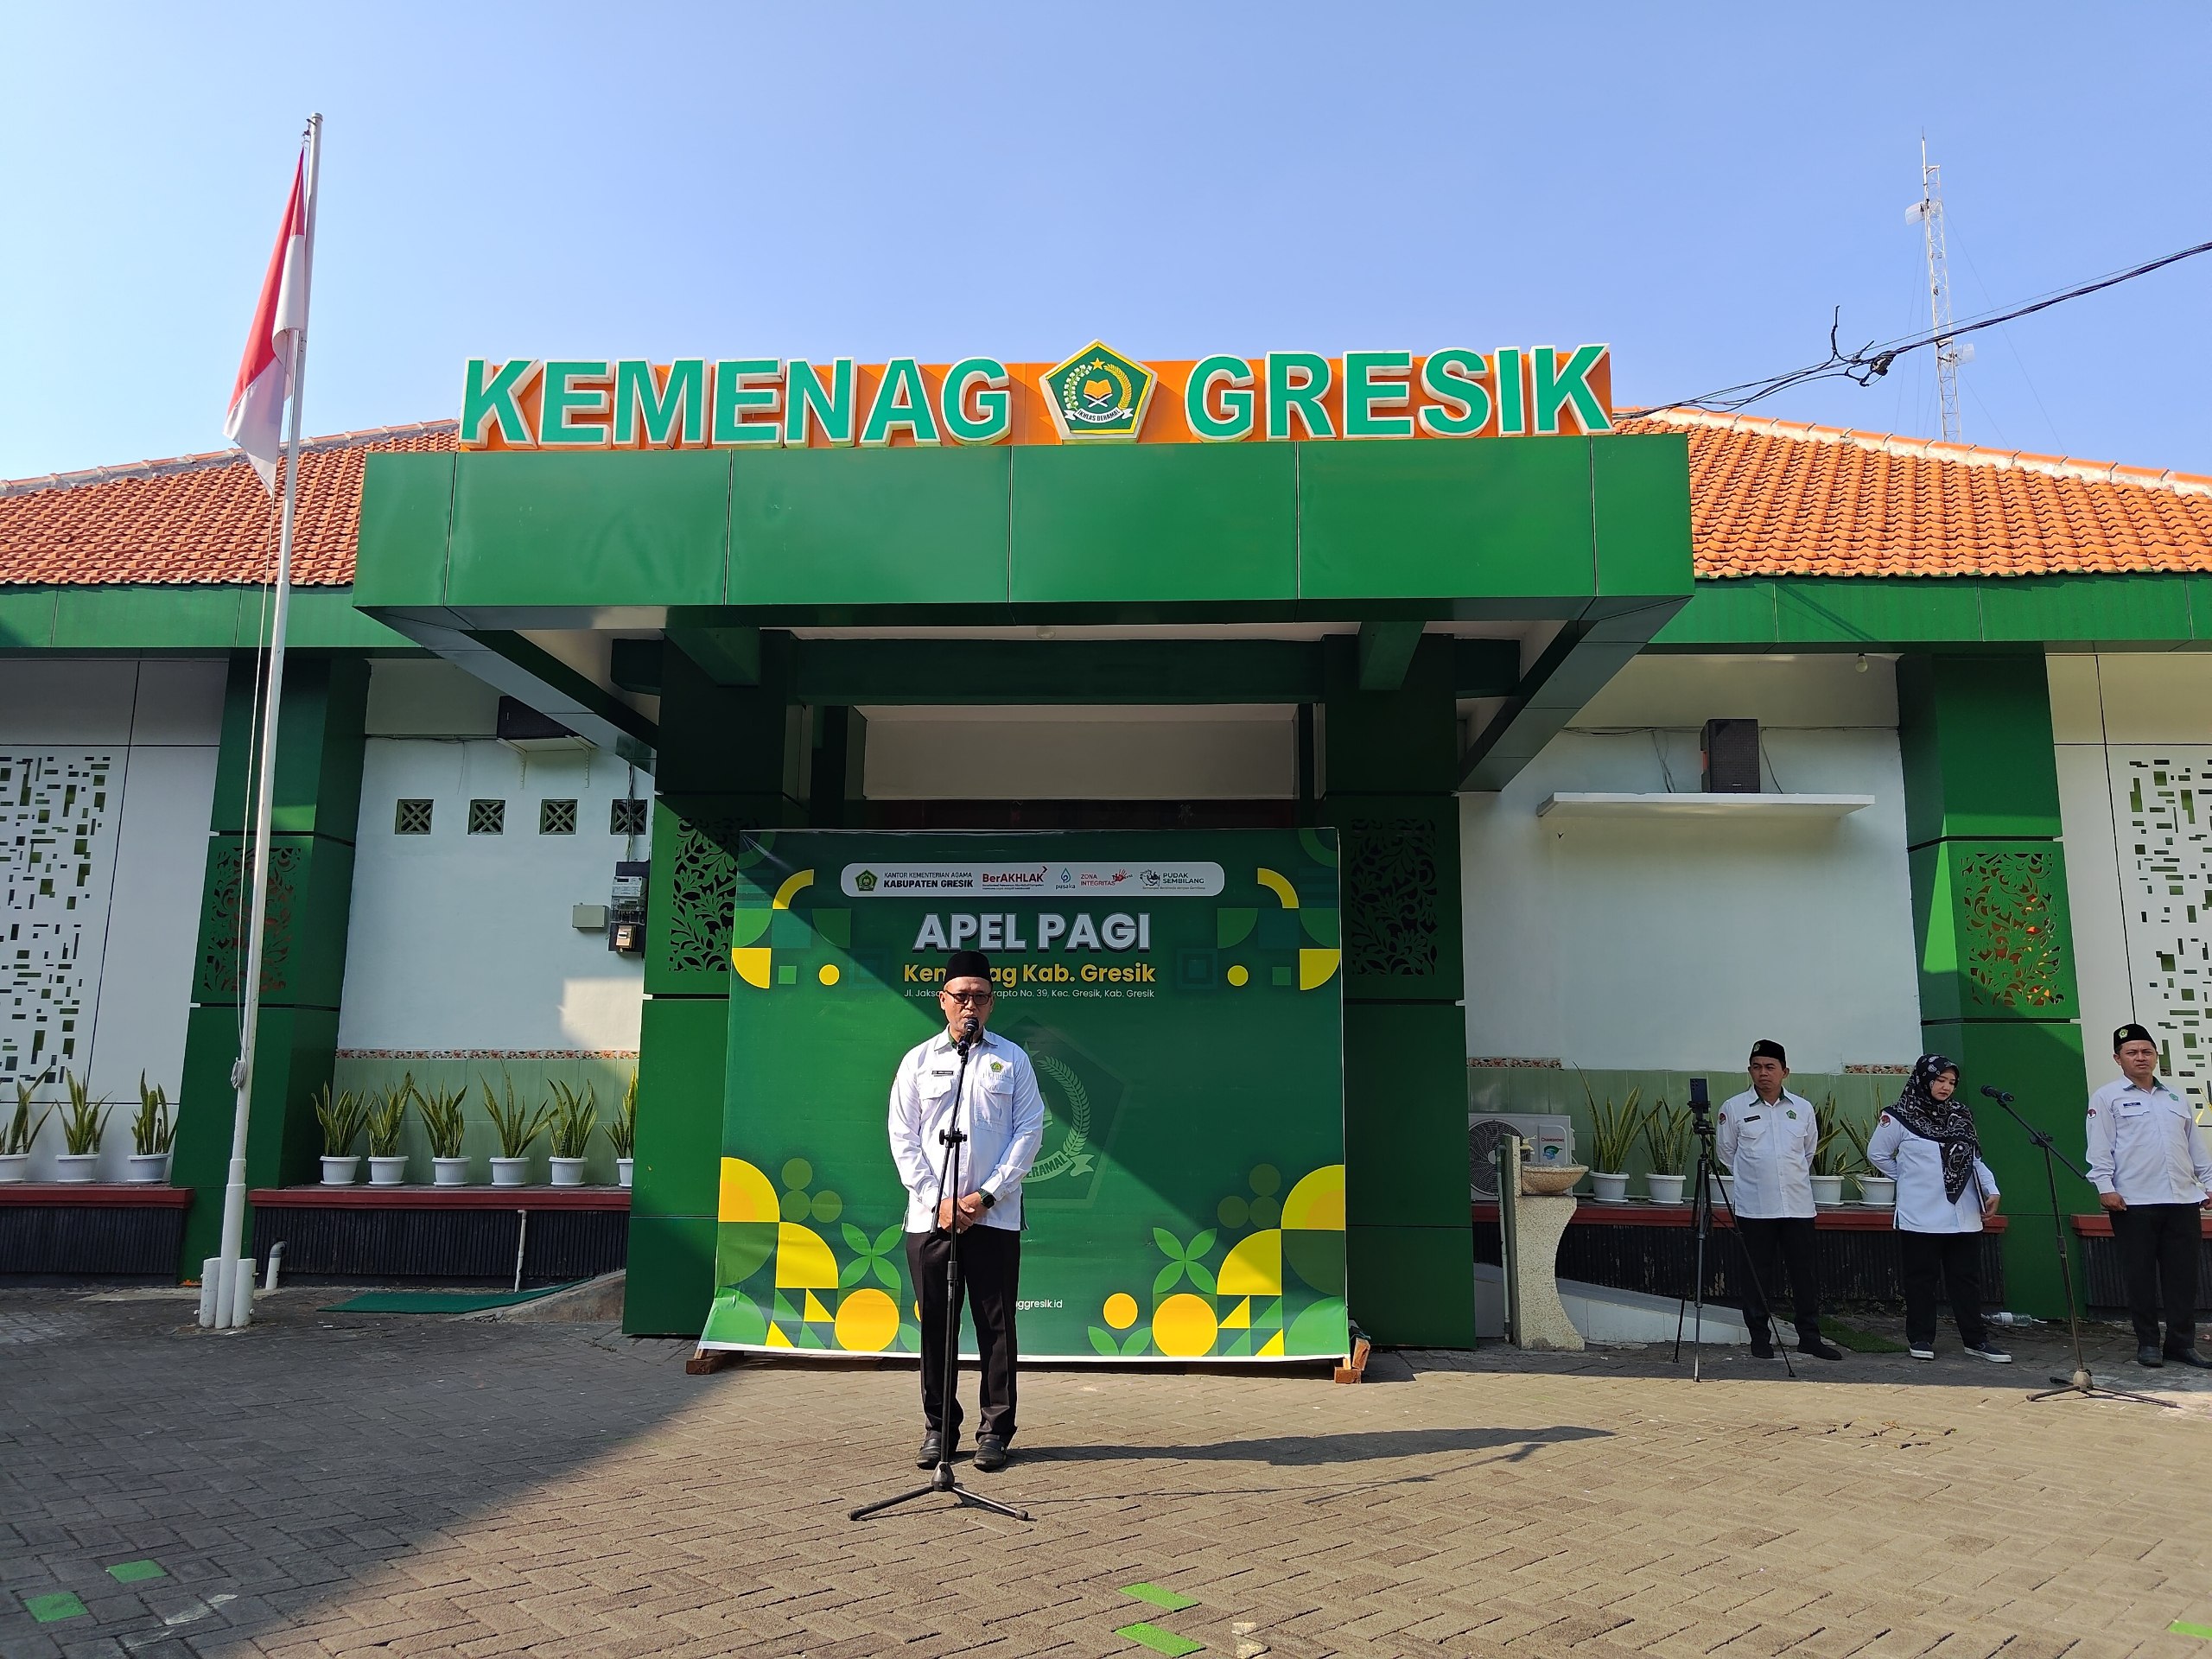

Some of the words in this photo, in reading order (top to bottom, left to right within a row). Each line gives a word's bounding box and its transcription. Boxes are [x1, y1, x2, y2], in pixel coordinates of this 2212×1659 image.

[460, 357, 1012, 448] KEMENAG
[1185, 343, 1612, 441] GRESIK
[883, 880, 938, 888] KABUPATEN
[940, 880, 974, 888] GRESIK
[982, 873, 1044, 883] BerAKHLAK
[912, 912, 1027, 951] APEL
[1037, 912, 1151, 951] PAGI
[1022, 963, 1076, 982] Kab.
[1080, 963, 1156, 982] Gresik
[904, 988, 913, 997] Jl.
[1036, 989, 1049, 999] 39,
[1072, 988, 1102, 999] Gresik,
[1104, 988, 1125, 997] Kab.
[1126, 988, 1154, 998] Gresik
[1026, 1154, 1068, 1179] ERAMAL
